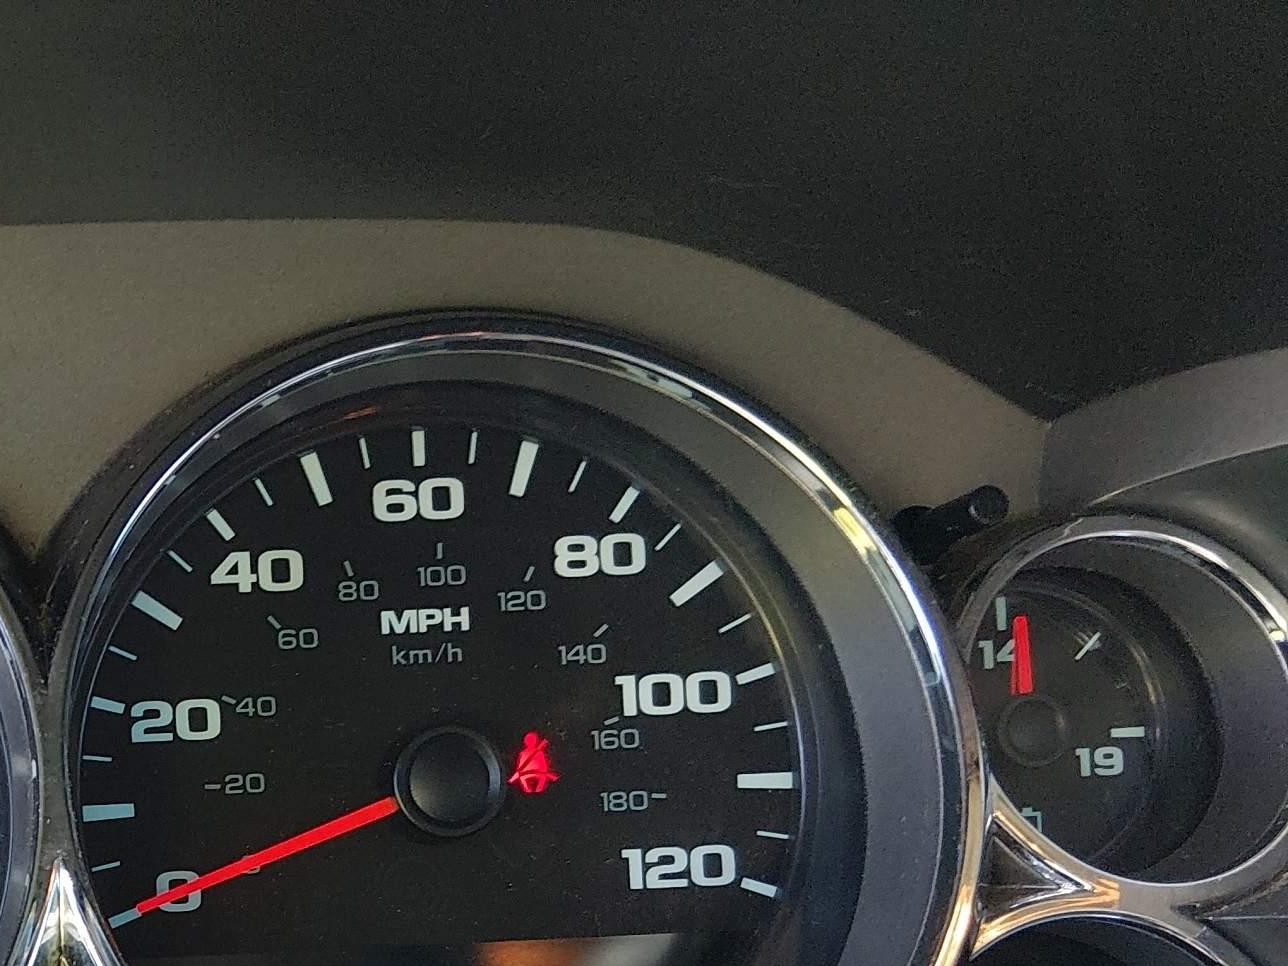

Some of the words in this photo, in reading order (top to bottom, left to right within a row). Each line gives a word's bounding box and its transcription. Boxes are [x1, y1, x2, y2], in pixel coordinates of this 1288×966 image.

[372, 477, 465, 522] 60
[553, 532, 646, 578] 80
[210, 549, 304, 593] 40
[417, 565, 467, 587] 100
[338, 579, 380, 601] 80
[497, 589, 547, 612] 120
[380, 607, 470, 635] MPH
[277, 628, 319, 650] 60
[391, 643, 463, 665] km/h
[558, 642, 607, 665] 140
[615, 671, 733, 716] 100
[235, 695, 277, 717] 40
[130, 698, 223, 743] 20
[591, 727, 640, 751] 160
[1075, 746, 1124, 777] 19
[223, 773, 265, 795] 20
[600, 790, 649, 812] 180
[622, 845, 736, 891] 120
[156, 870, 202, 912] 0
